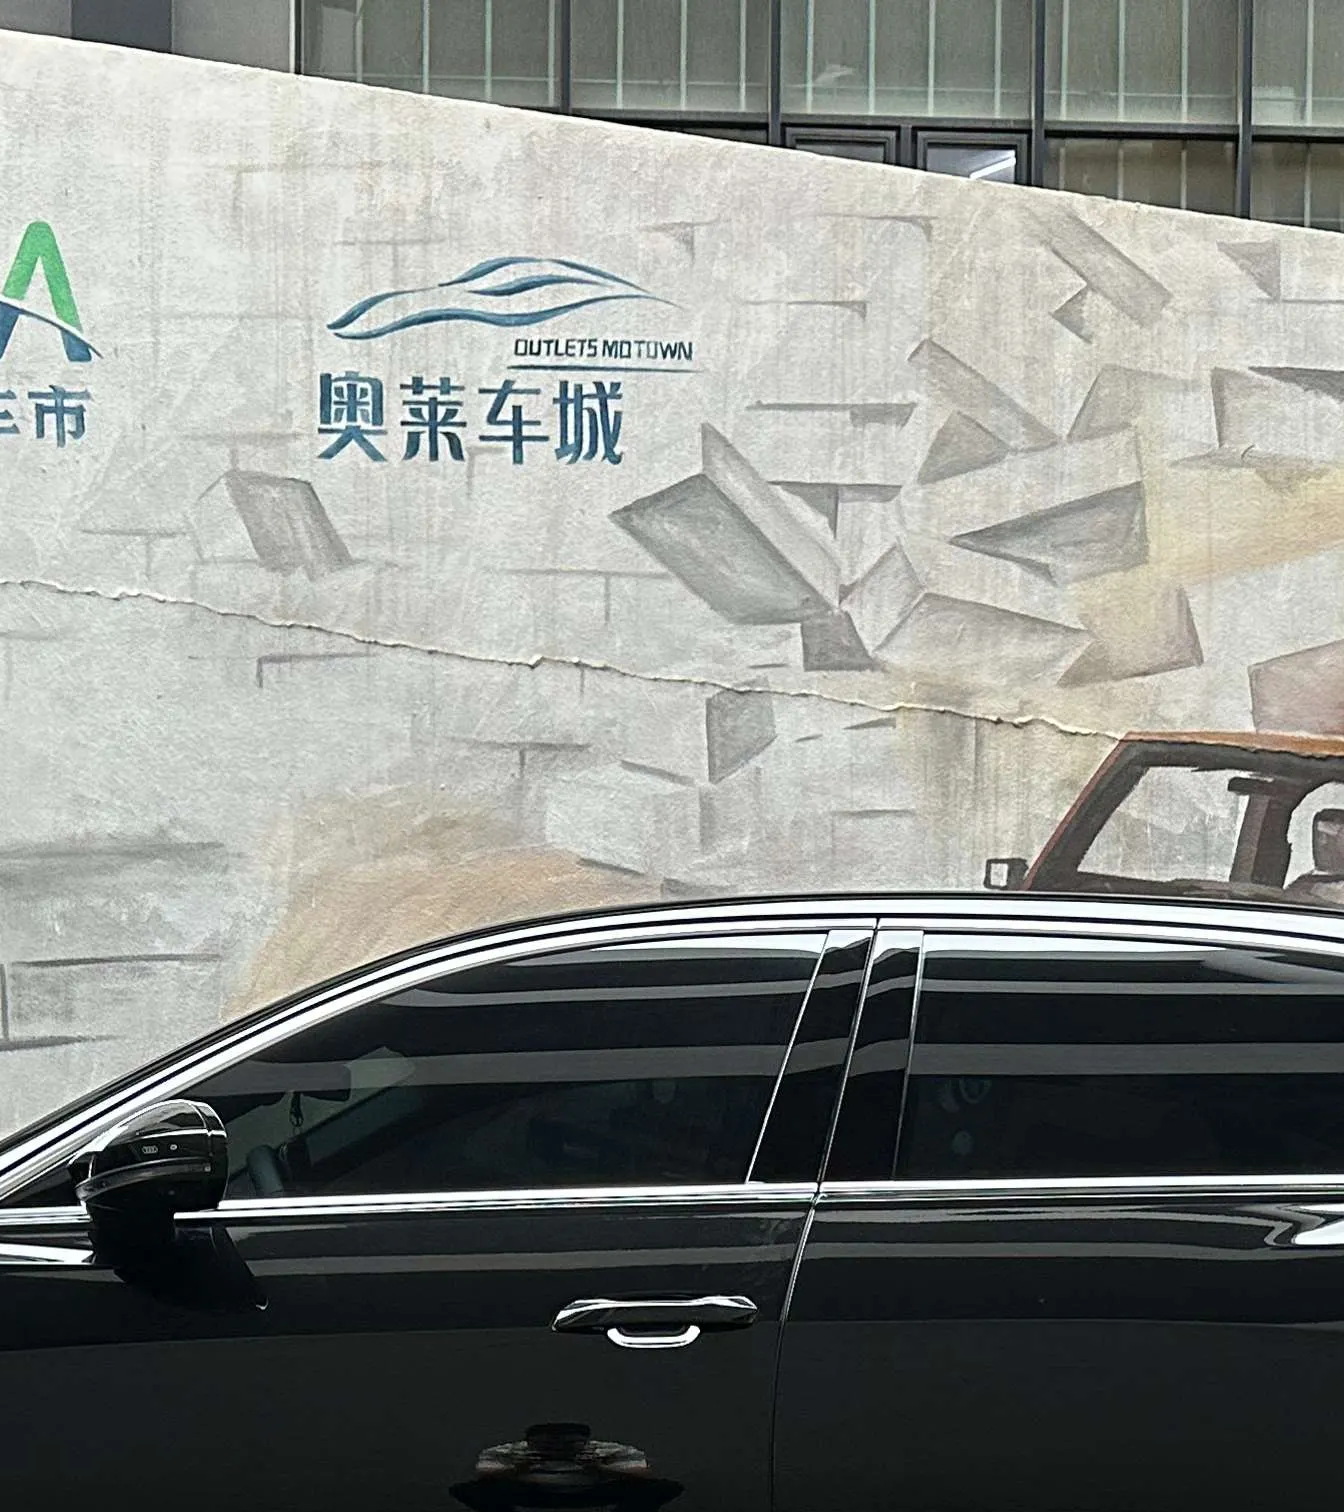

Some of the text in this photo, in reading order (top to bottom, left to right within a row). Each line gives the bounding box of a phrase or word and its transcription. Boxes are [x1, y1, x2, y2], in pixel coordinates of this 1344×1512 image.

[513, 338, 694, 361] OUTLETS MOTOWN
[317, 370, 624, 465] 奥莱车城
